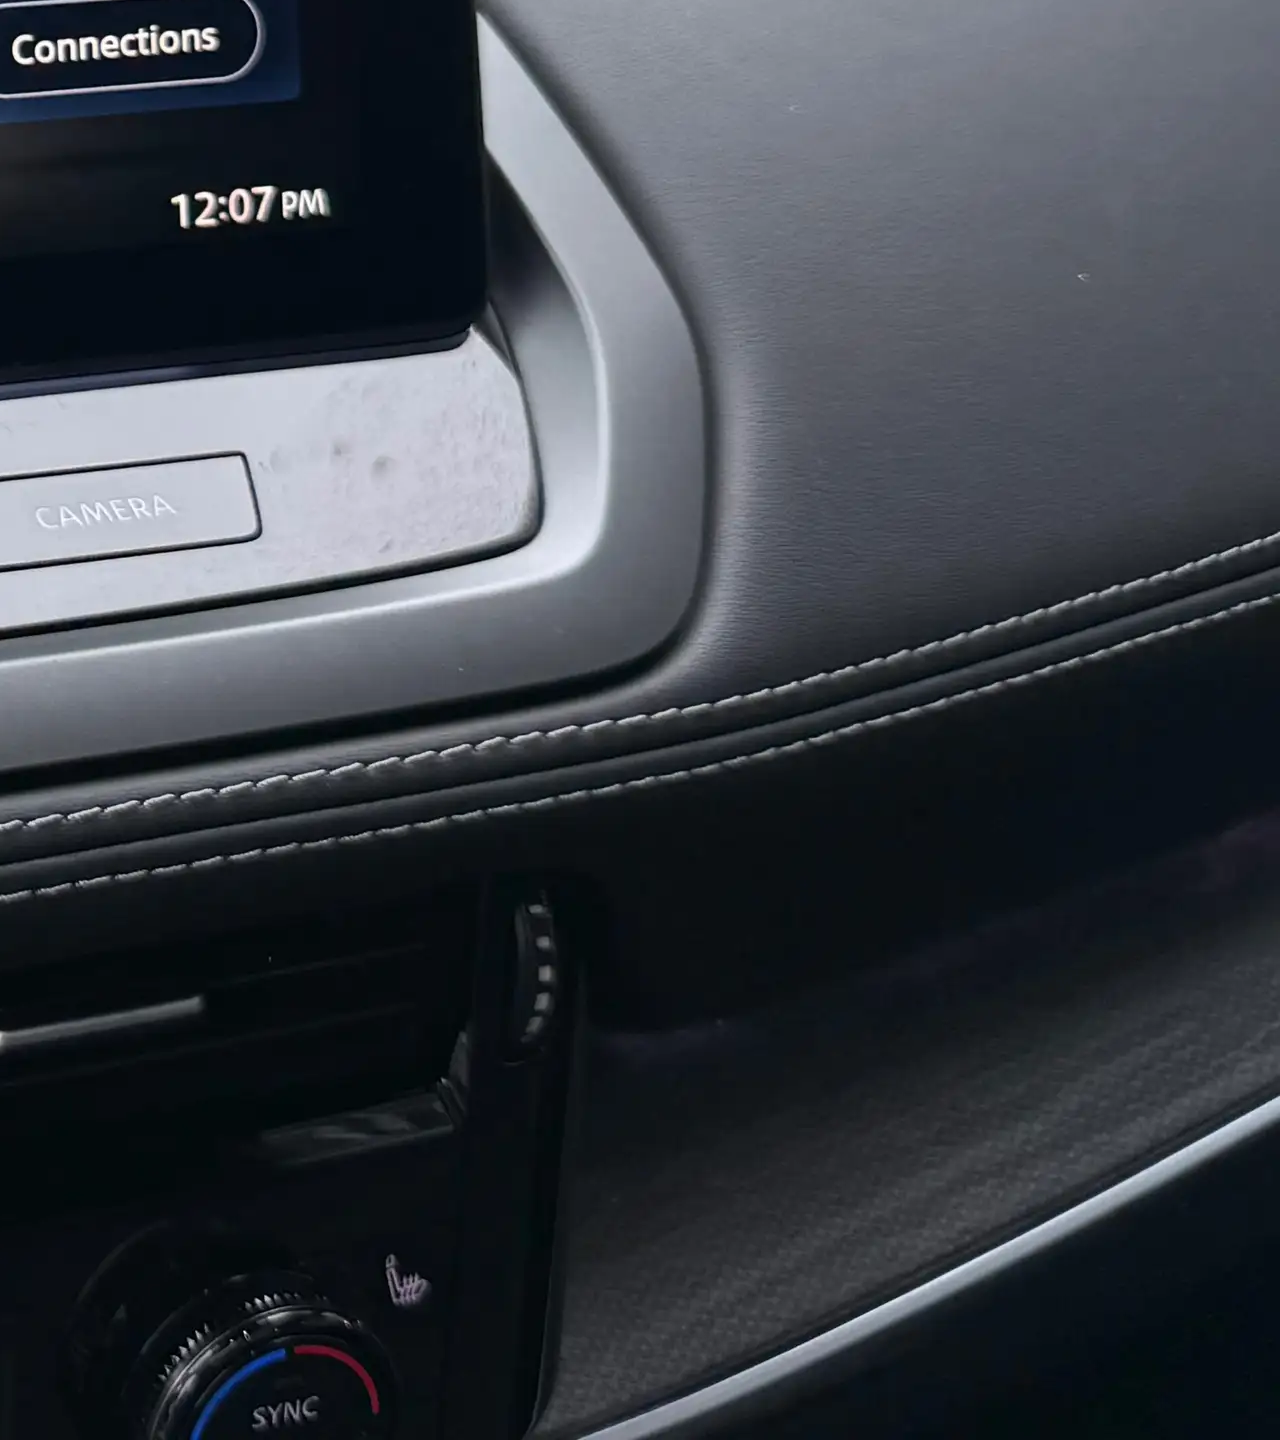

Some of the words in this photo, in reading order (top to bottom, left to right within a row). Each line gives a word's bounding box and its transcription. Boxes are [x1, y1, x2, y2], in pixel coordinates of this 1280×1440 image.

[12, 24, 220, 65] Connections
[171, 185, 278, 229] 12:07
[282, 188, 331, 220] PM
[35, 495, 178, 530] CAMERA
[252, 1396, 320, 1429] SYNC
